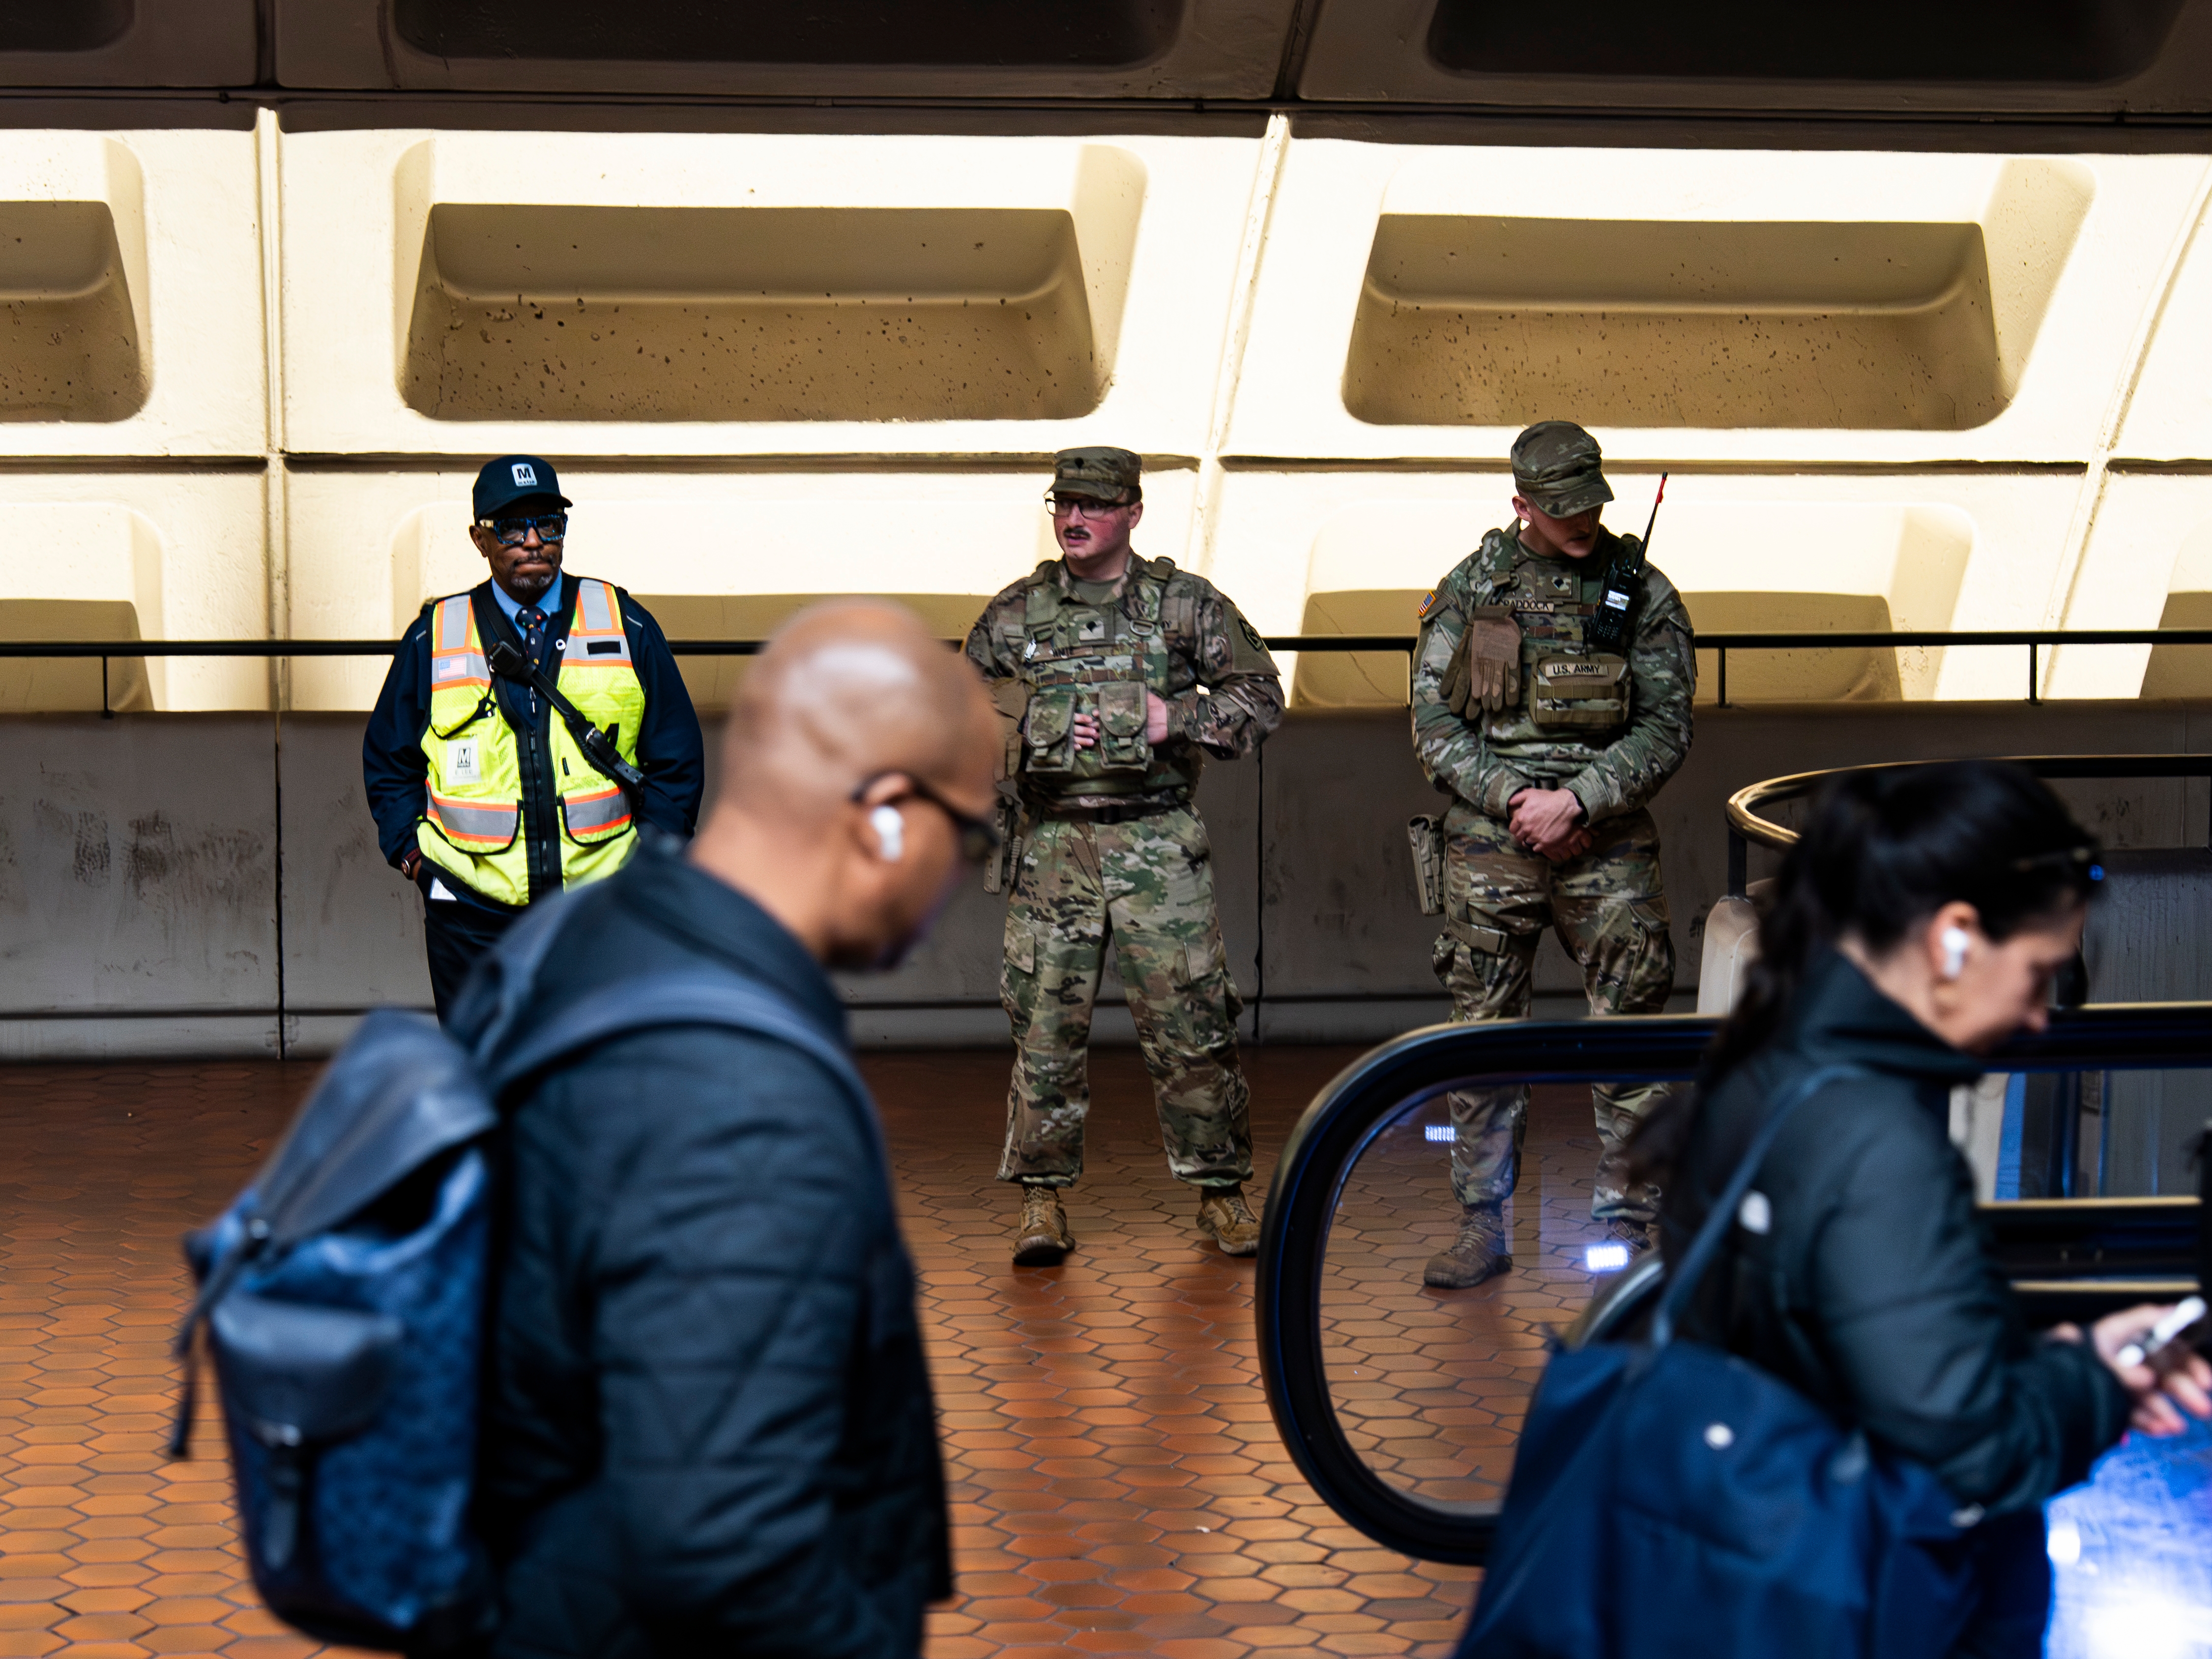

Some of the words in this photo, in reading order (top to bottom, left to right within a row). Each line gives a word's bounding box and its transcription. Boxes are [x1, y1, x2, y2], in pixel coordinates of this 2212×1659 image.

[517, 467, 531, 479] M
[1553, 664, 1571, 675] U.S.
[1574, 664, 1600, 674] ARMY
